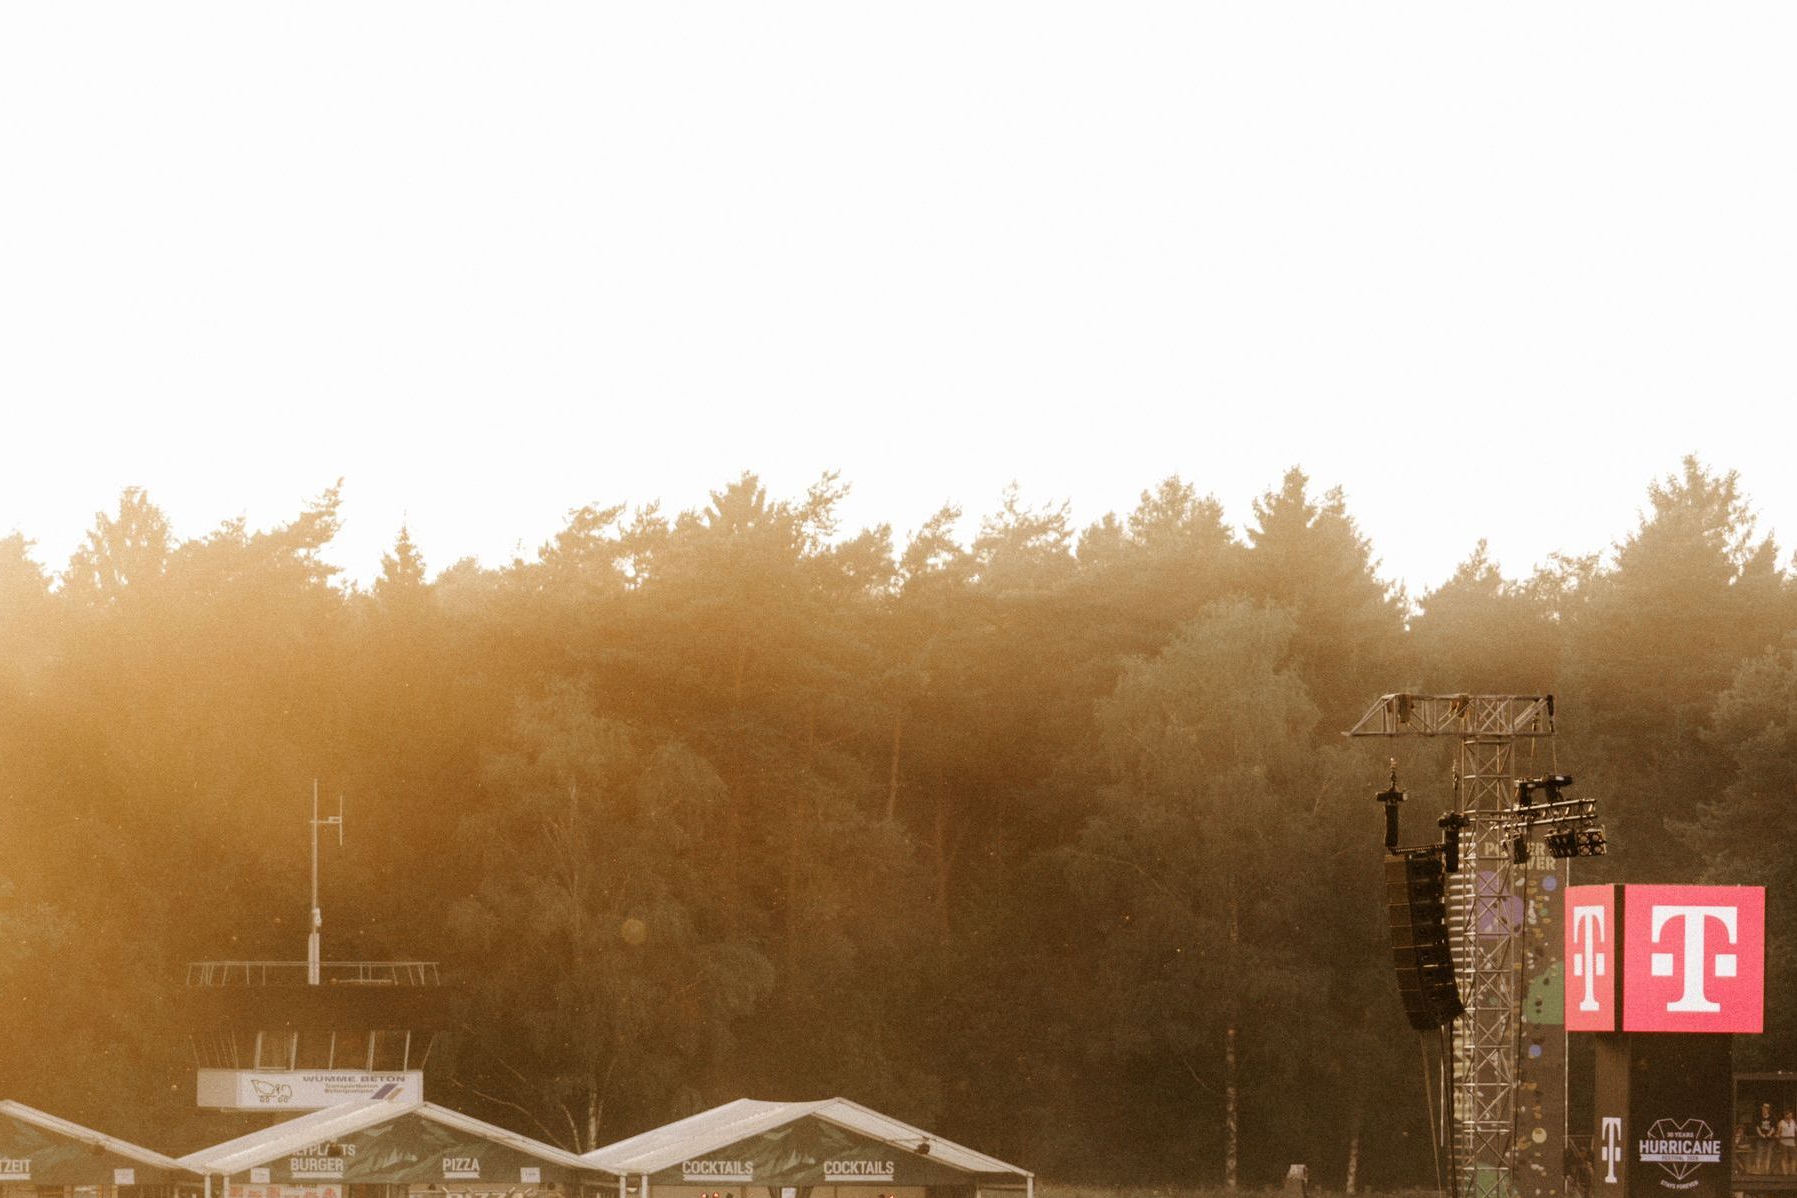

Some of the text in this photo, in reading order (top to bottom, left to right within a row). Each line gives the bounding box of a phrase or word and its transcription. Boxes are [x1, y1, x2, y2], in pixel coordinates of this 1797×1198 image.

[1573, 906, 1605, 1011] T
[1652, 905, 1738, 1012] T
[1602, 1117, 1622, 1183] T
[1639, 1140, 1721, 1154] HURRICANE
[290, 1158, 344, 1171] BURGER
[443, 1158, 480, 1171] PIZZA
[682, 1160, 753, 1175] COCKTAILS
[823, 1161, 895, 1175] COCKTAILS
